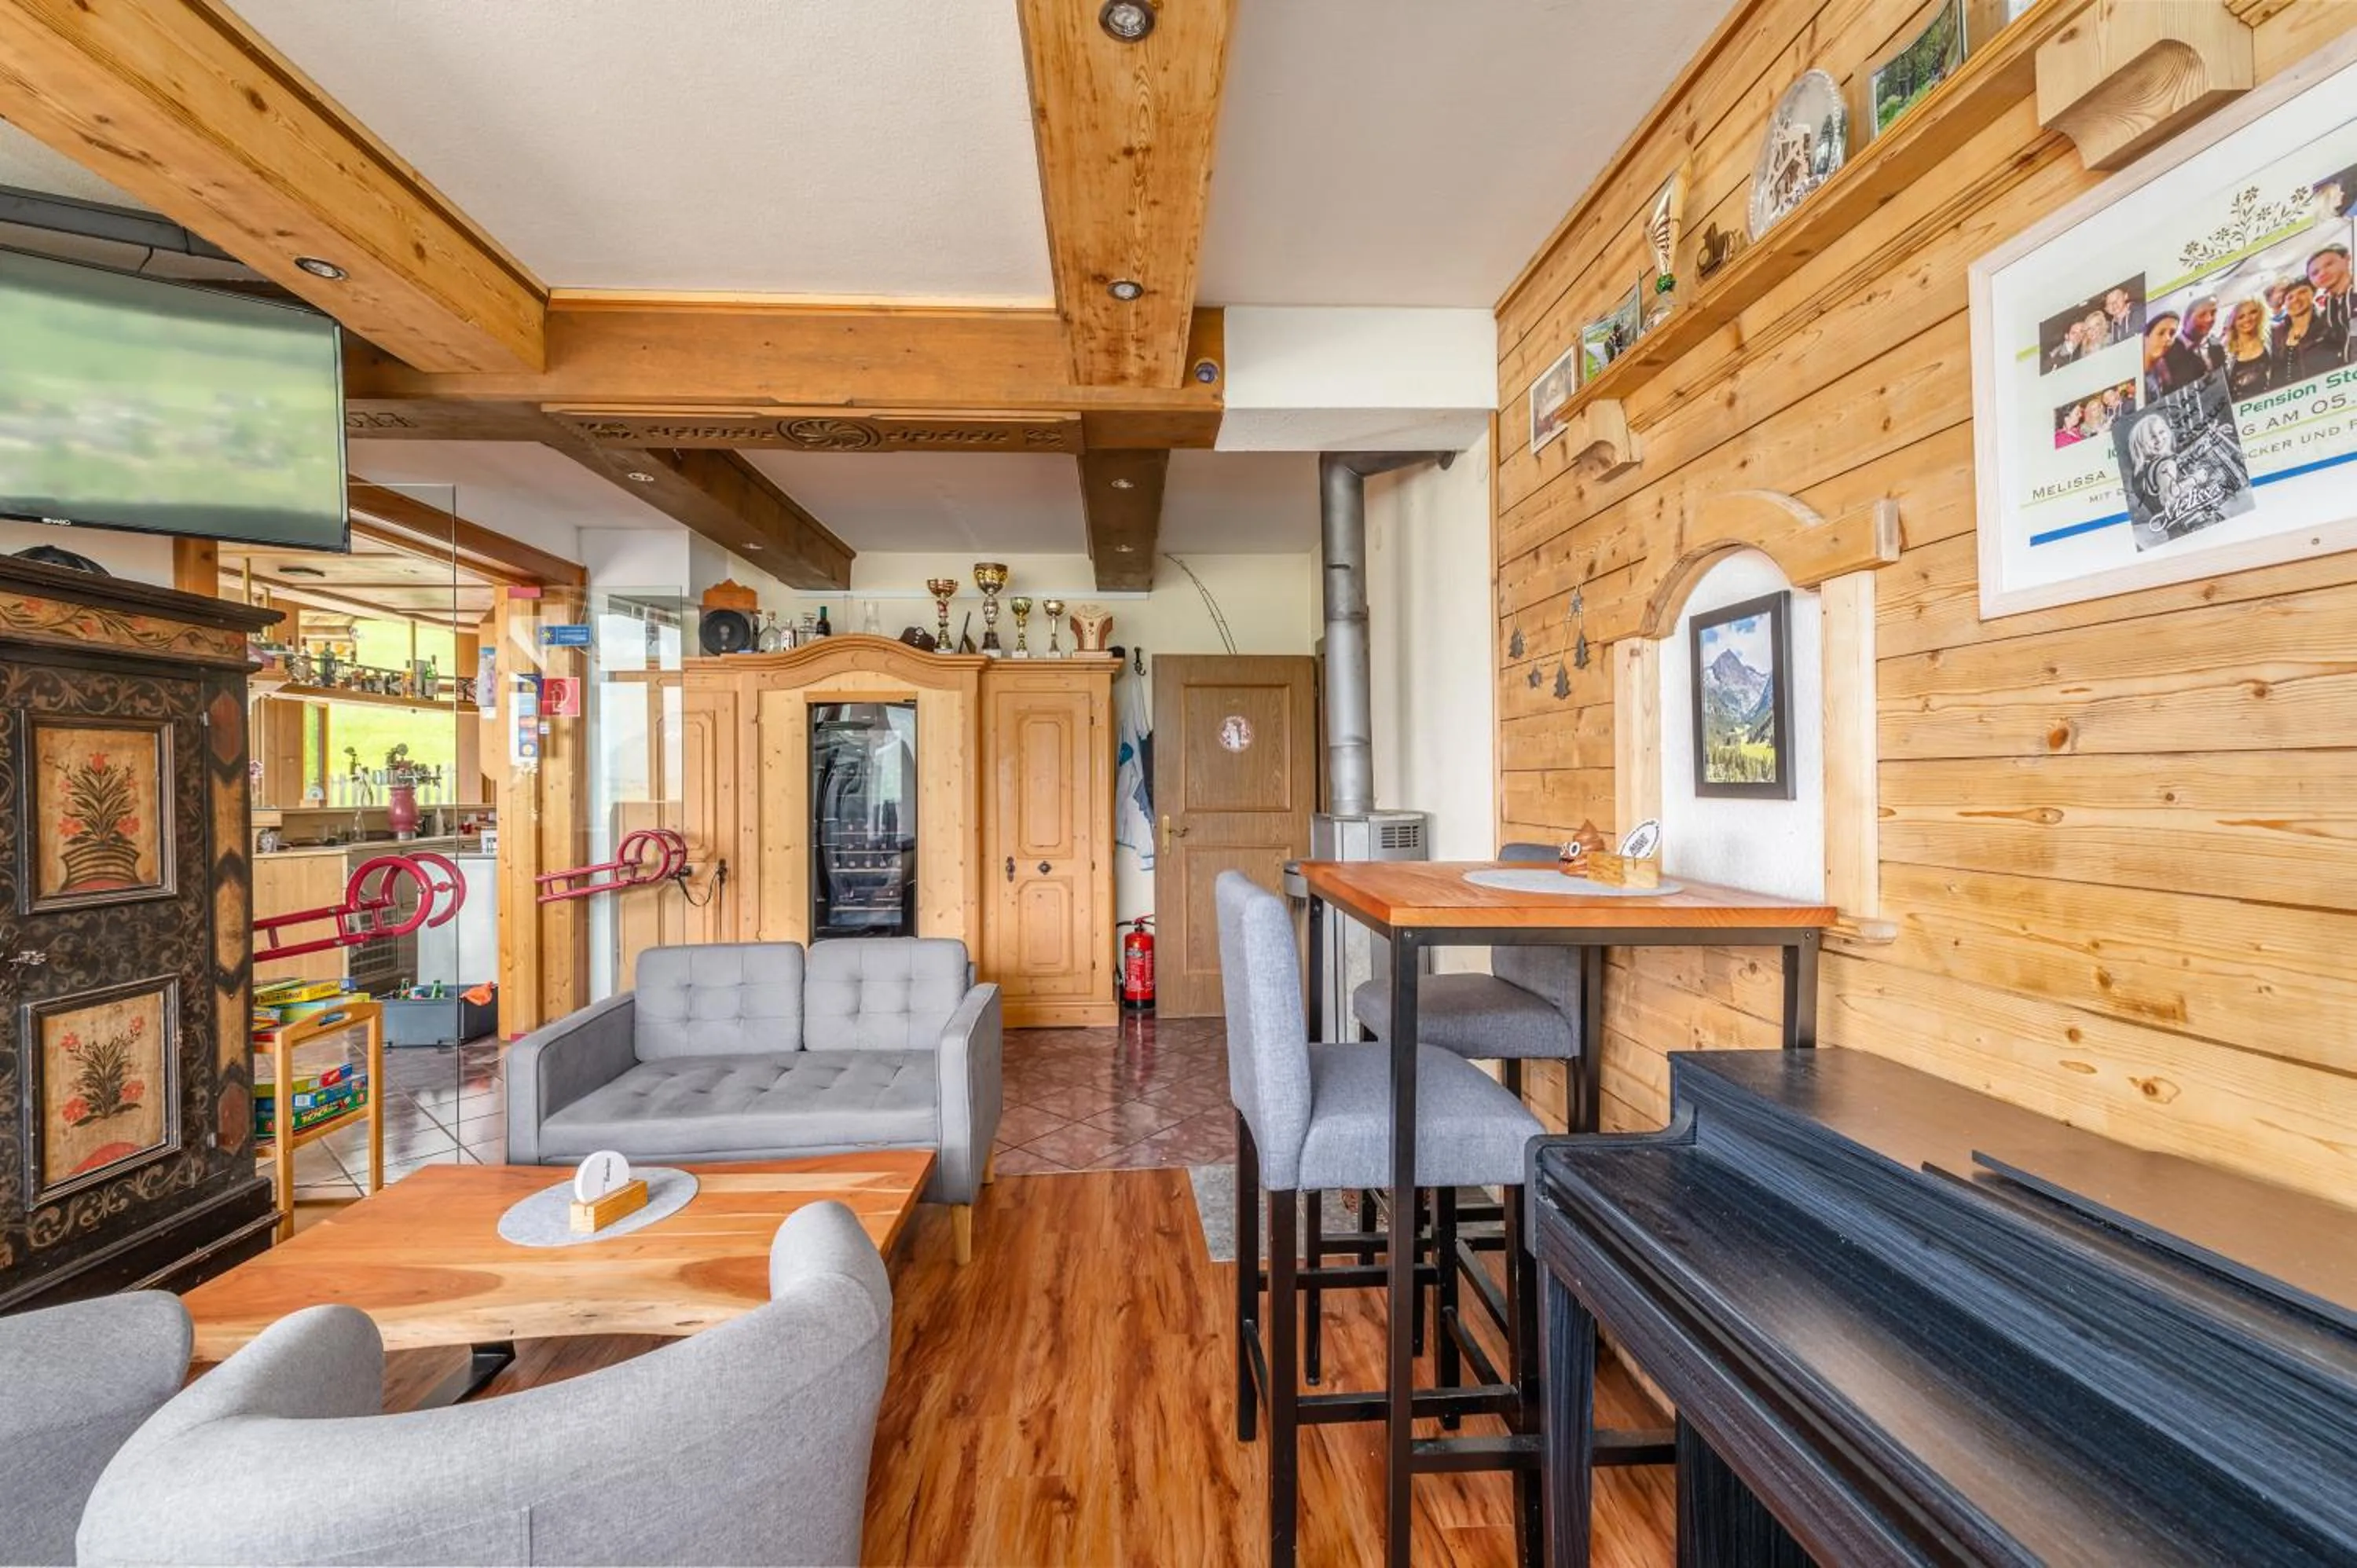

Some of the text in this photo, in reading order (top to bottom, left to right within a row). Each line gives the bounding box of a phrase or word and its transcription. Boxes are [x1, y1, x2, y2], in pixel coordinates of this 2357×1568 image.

[2240, 383, 2317, 417] Pension
[2032, 470, 2106, 500] MELISSA
[2266, 410, 2299, 430] AM
[2089, 491, 2112, 504] MIT
[2301, 427, 2341, 444] UND
